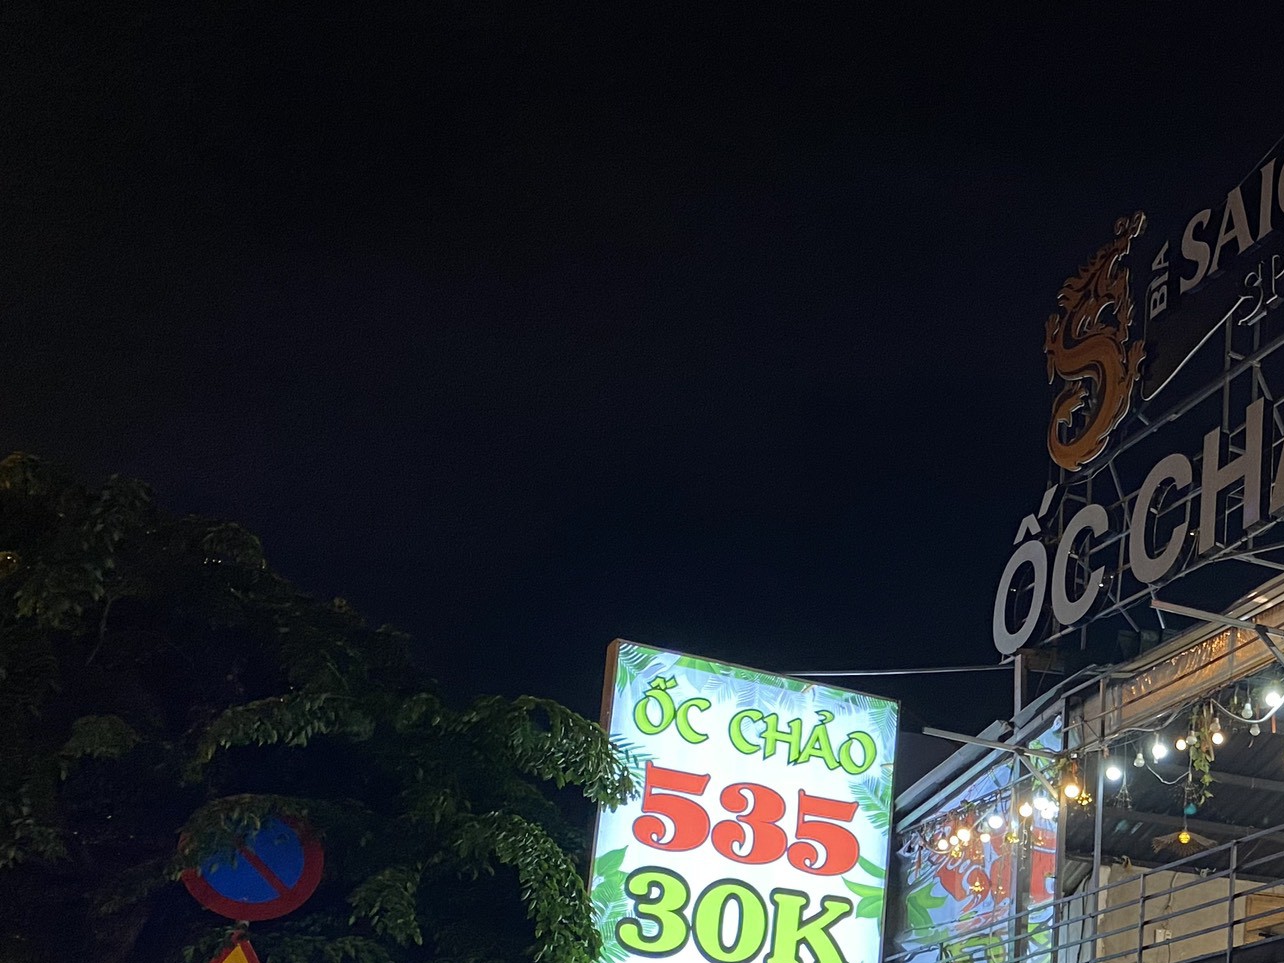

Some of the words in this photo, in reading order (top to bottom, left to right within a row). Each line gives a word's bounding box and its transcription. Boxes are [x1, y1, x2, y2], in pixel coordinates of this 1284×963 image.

[1149, 241, 1170, 321] BIA
[991, 484, 1109, 656] ỐC
[634, 676, 712, 745] ỐC
[729, 709, 877, 775] CHẢO
[632, 761, 861, 877] 535
